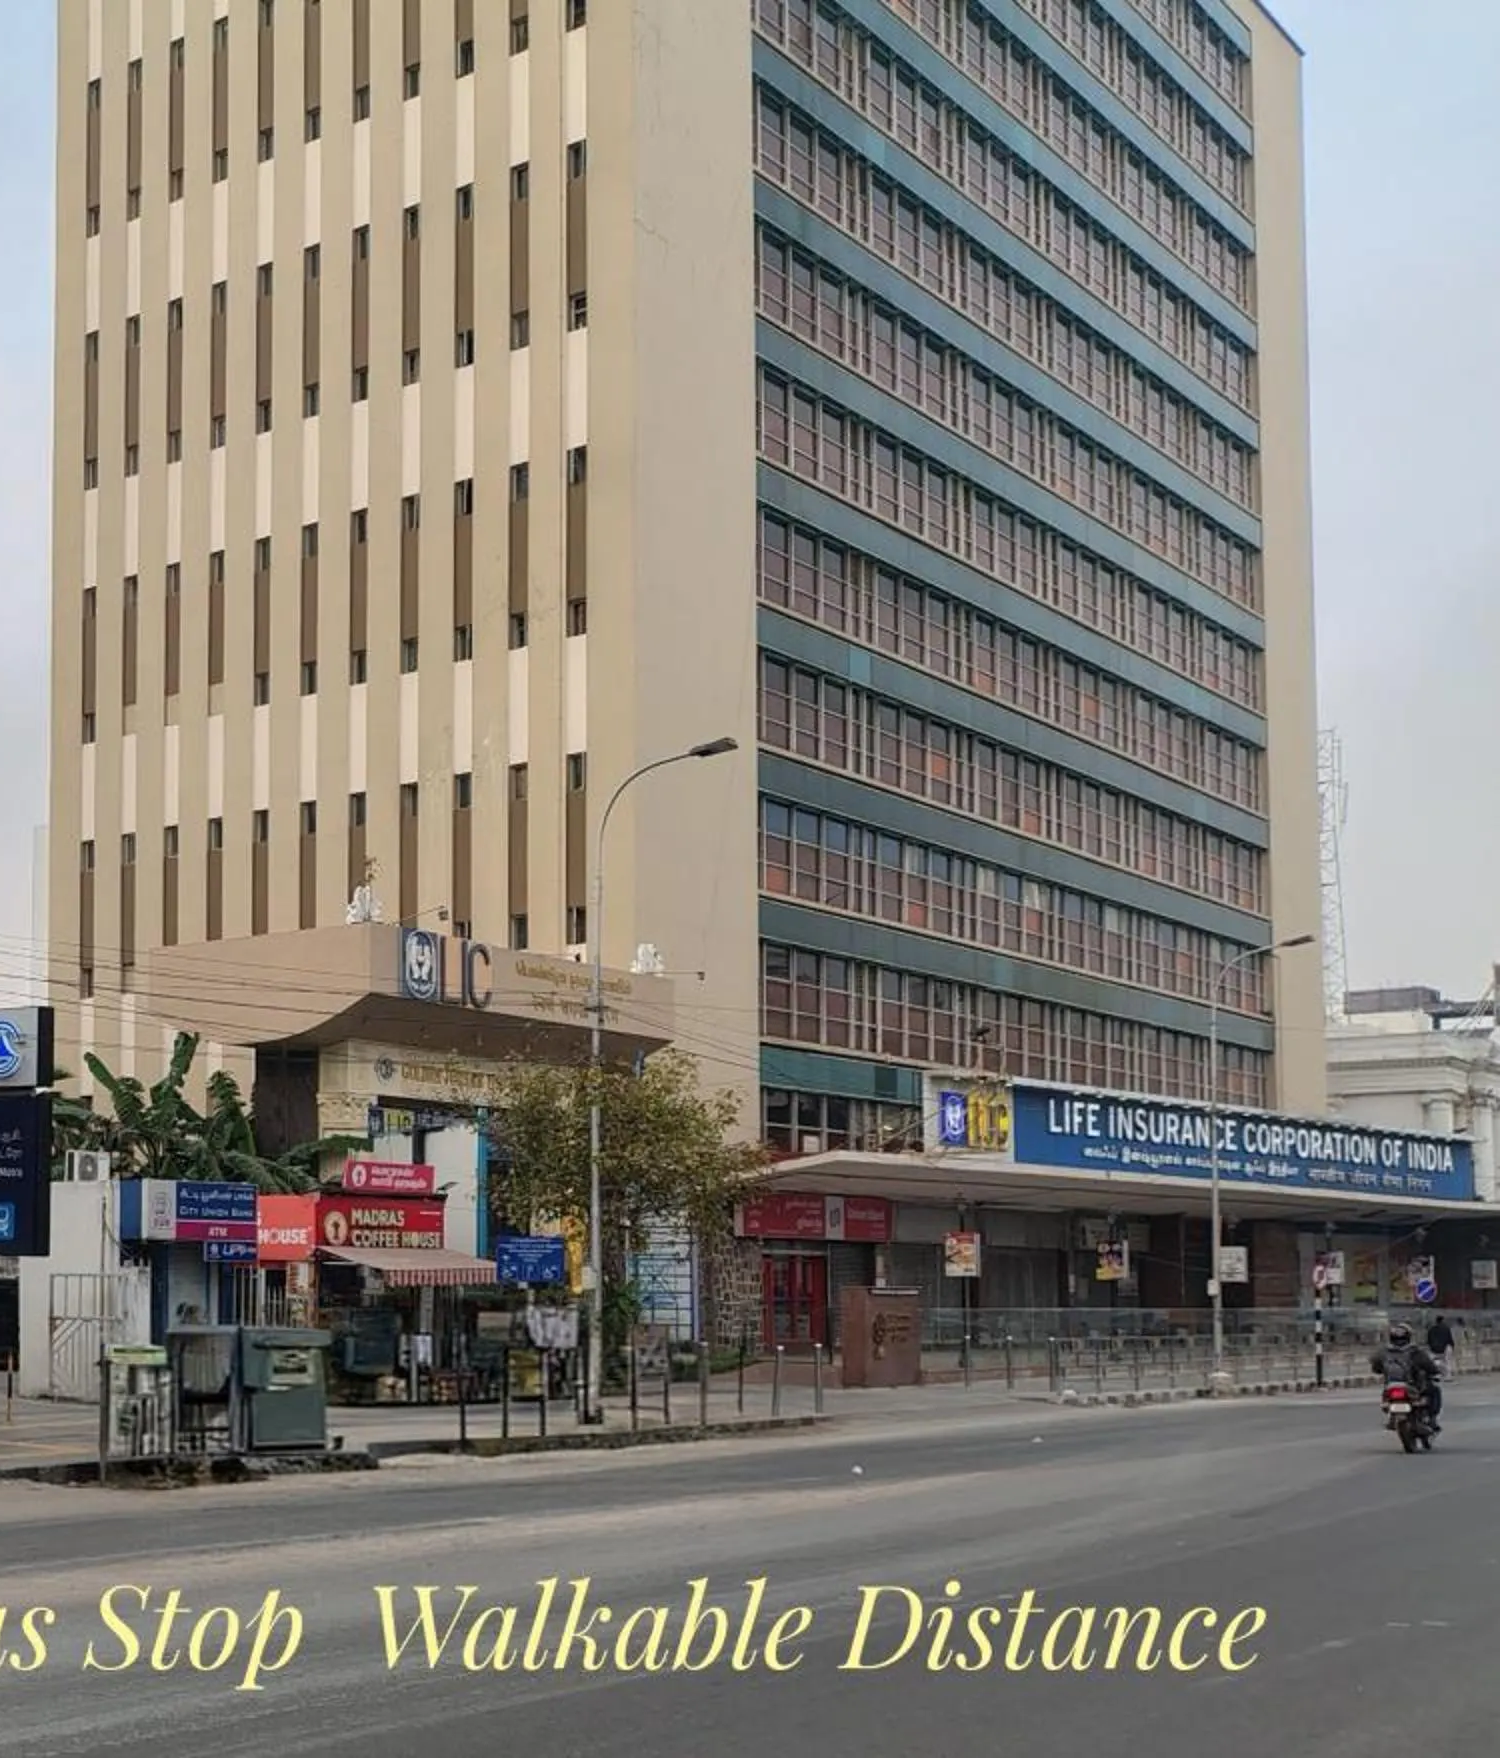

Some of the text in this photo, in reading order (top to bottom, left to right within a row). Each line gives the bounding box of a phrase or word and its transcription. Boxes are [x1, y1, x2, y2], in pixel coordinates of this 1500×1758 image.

[439, 934, 494, 1009] LIC
[1049, 1099, 1100, 1136] LIFE
[1108, 1106, 1238, 1151] INSURANCE
[1243, 1121, 1376, 1165] CORPORATION
[1381, 1139, 1404, 1168] OF
[1407, 1142, 1453, 1173] INDIA
[351, 1207, 405, 1228] MADRAS
[208, 1226, 228, 1237] ATM
[258, 1227, 308, 1245] HOUSE
[351, 1229, 441, 1249] COFFEE HOUSE
